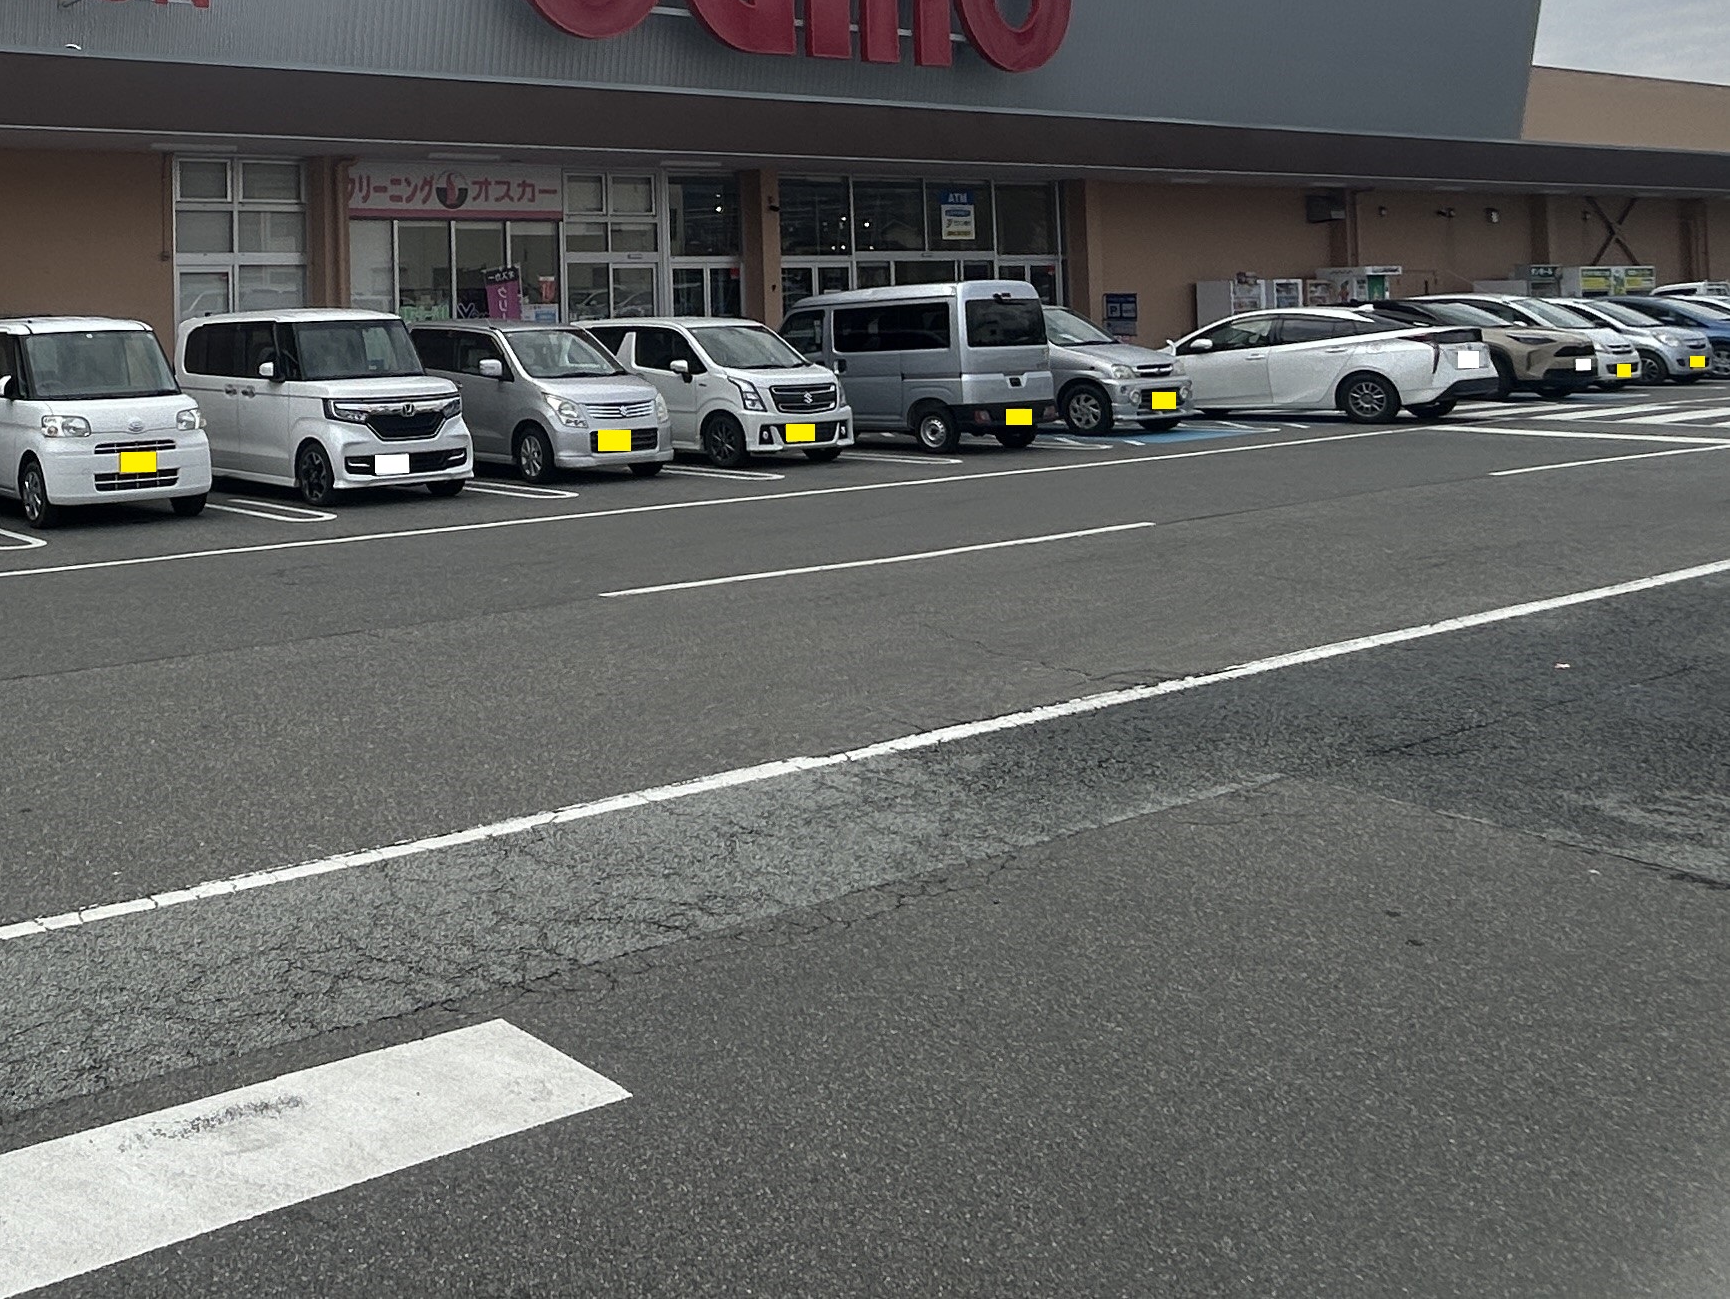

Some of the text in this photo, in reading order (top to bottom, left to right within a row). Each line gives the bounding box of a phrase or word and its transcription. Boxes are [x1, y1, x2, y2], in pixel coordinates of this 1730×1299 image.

[471, 177, 558, 203] オスカー
[948, 193, 967, 202] ATM
